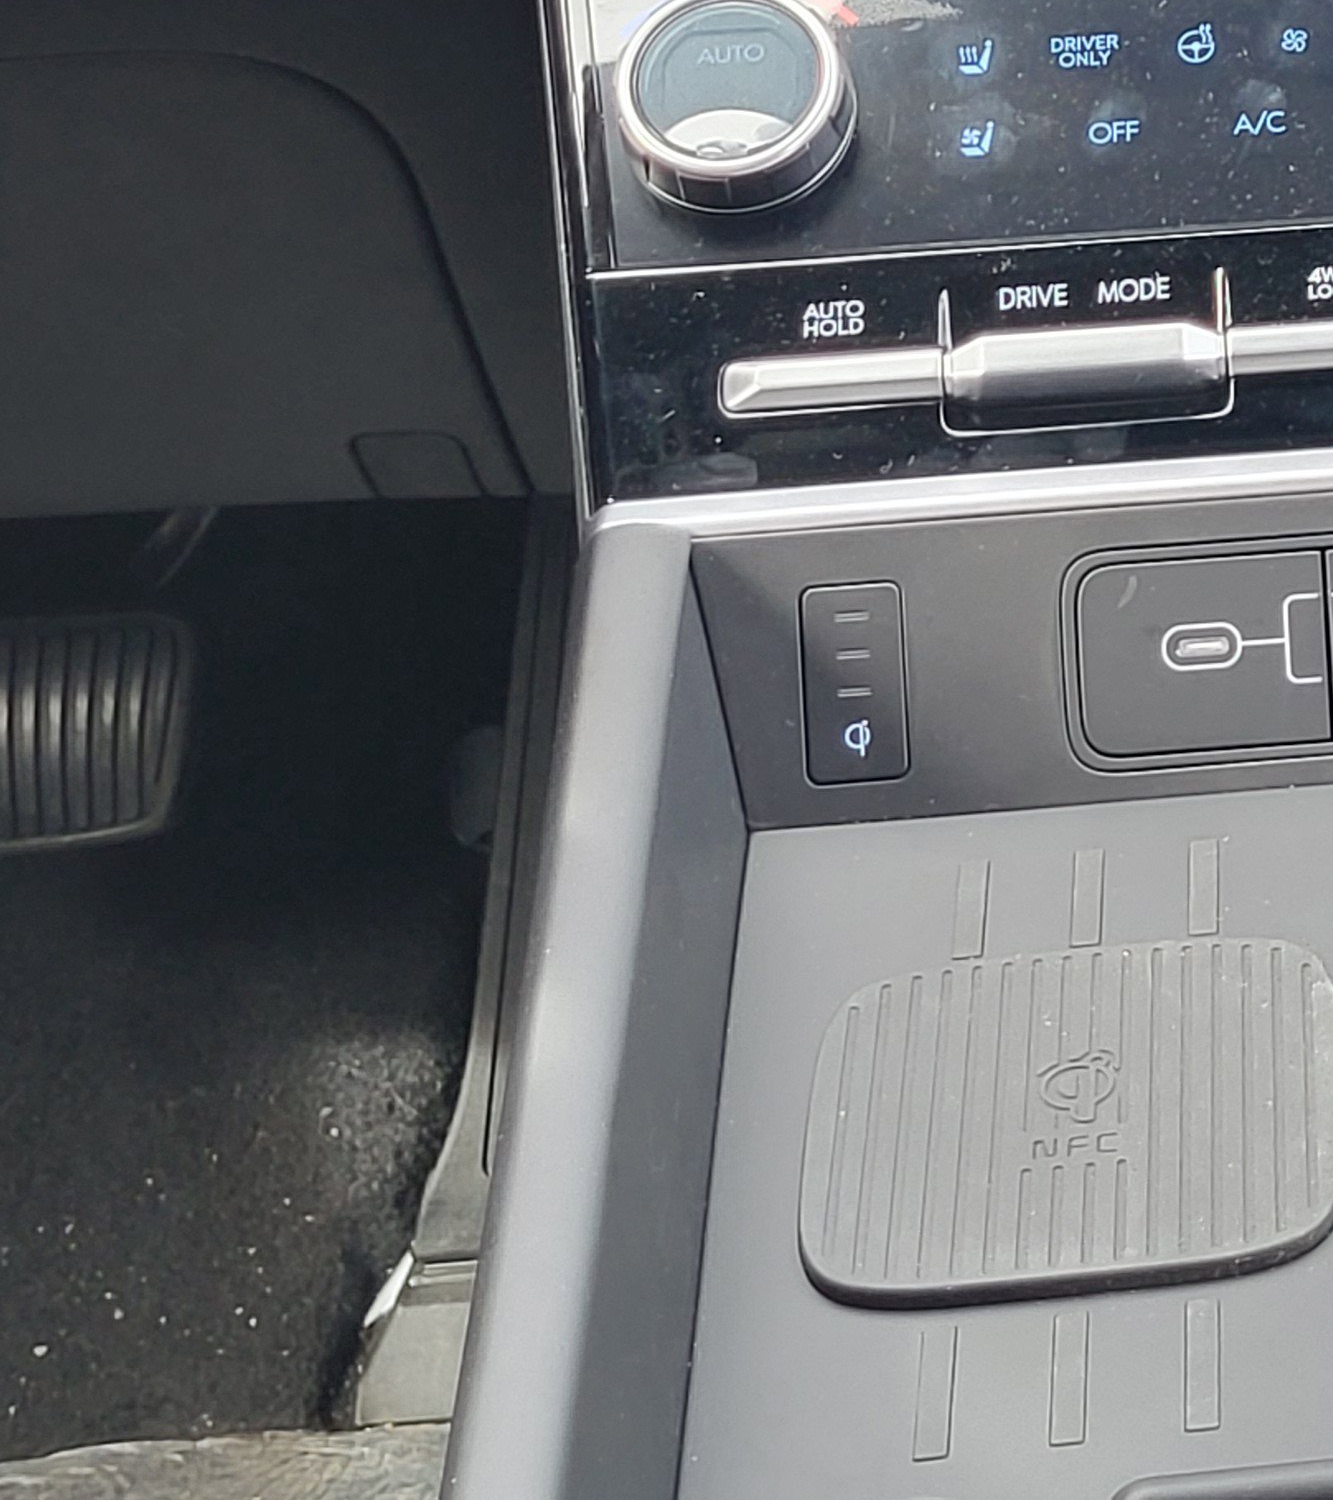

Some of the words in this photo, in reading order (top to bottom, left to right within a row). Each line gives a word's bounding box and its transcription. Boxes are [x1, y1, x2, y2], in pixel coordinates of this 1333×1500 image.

[697, 43, 765, 65] AUTO
[1050, 34, 1120, 54] DRIVER
[1058, 50, 1112, 68] ONLY
[1088, 120, 1141, 144] OFF
[1232, 110, 1288, 136] A/C
[999, 283, 1069, 311] DRIVE
[1097, 276, 1171, 304] MODE
[803, 300, 866, 320] AUTO
[803, 318, 866, 338] HOLD
[1032, 1131, 1118, 1160] NFC
